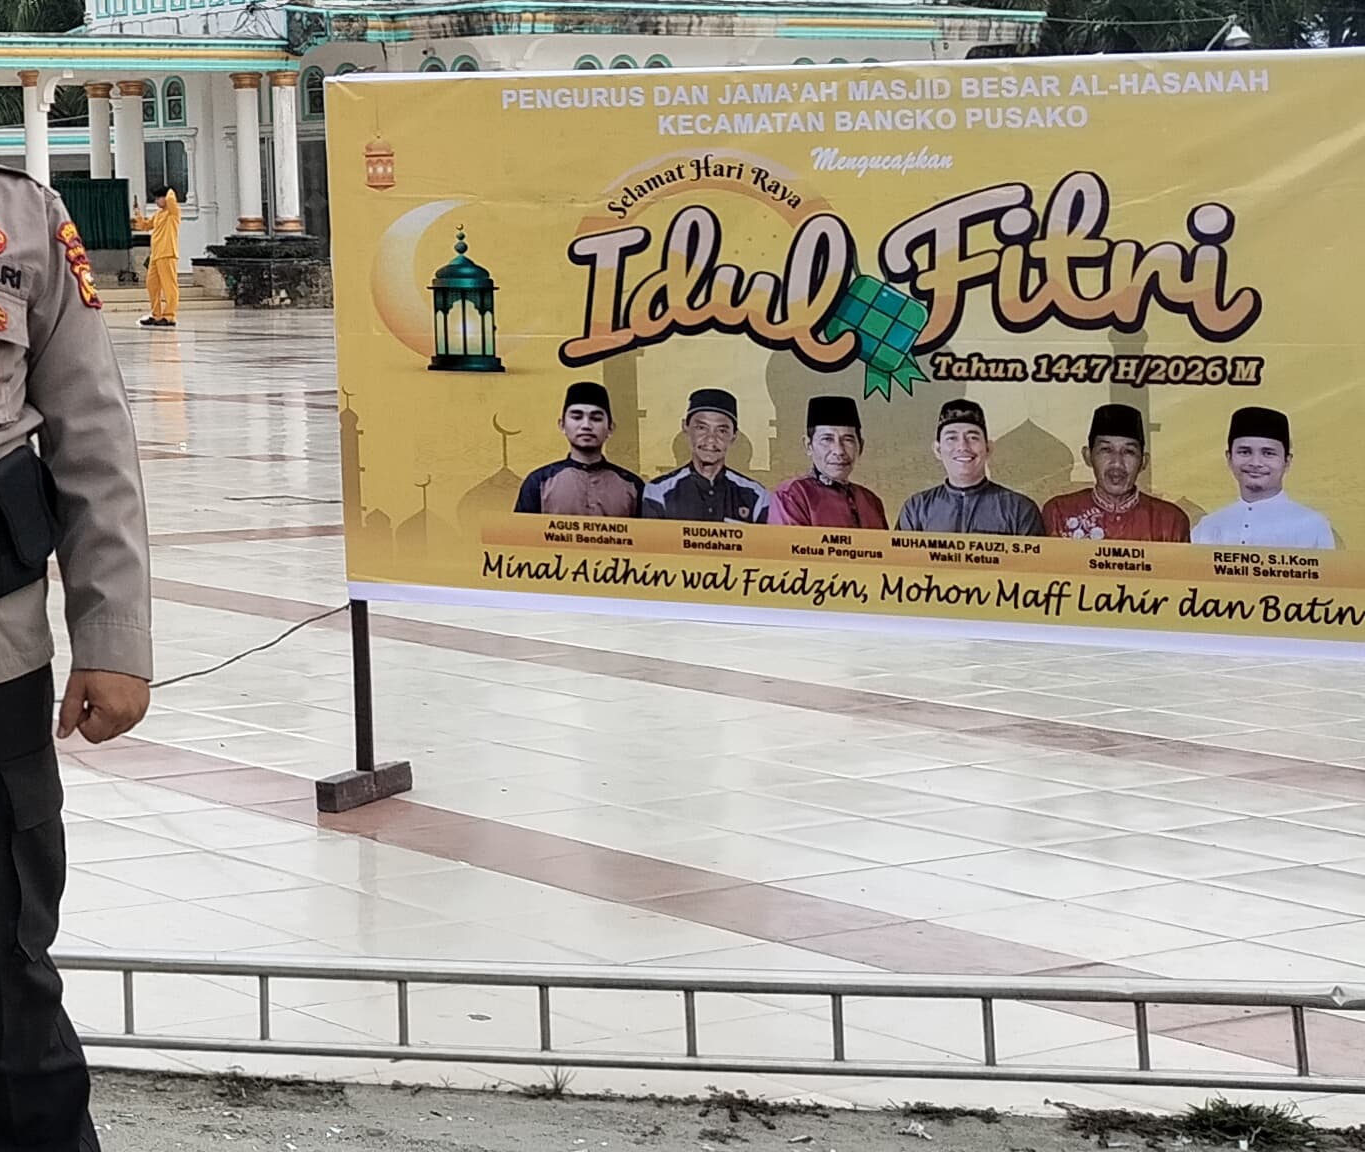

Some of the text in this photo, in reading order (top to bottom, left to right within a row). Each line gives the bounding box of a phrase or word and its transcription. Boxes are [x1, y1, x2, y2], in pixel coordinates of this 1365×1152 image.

[501, 86, 645, 110] PENGURUS
[653, 84, 708, 106] DAN
[847, 78, 951, 101] MASJID
[960, 76, 1061, 99] BESAR
[1069, 69, 1269, 97] AL-HASANAH
[657, 105, 1089, 135] KECAMATAN BANGKO PUSAKO
[810, 145, 954, 177] Mengucapkan
[607, 154, 802, 219] Selamat Hari Raya
[560, 172, 1260, 372] Idul Fitri
[932, 354, 1262, 386] Tahun 1447 H/2026 M
[548, 520, 628, 533] AGUS RIYANDI
[683, 527, 743, 539] RUDIANTO
[544, 532, 633, 546] Wakil Bendahara
[683, 539, 743, 551] Bendahara
[821, 534, 852, 545] AMRI
[891, 538, 1041, 554] MUHAMMAD FAUZI, S.Pd
[791, 544, 883, 559] Ketua Pengurus
[929, 551, 1000, 565] Wakil Ketua
[1095, 546, 1145, 559] JUMADI
[1089, 558, 1152, 572] Sekretaris
[1213, 552, 1319, 567] REFNO, S.I.Kom
[1214, 564, 1319, 580] Wakil Sekretaris
[482, 551, 1365, 626] Minal Aidhin wal Faidzin, Mohon Maff Lahir dan Batin
